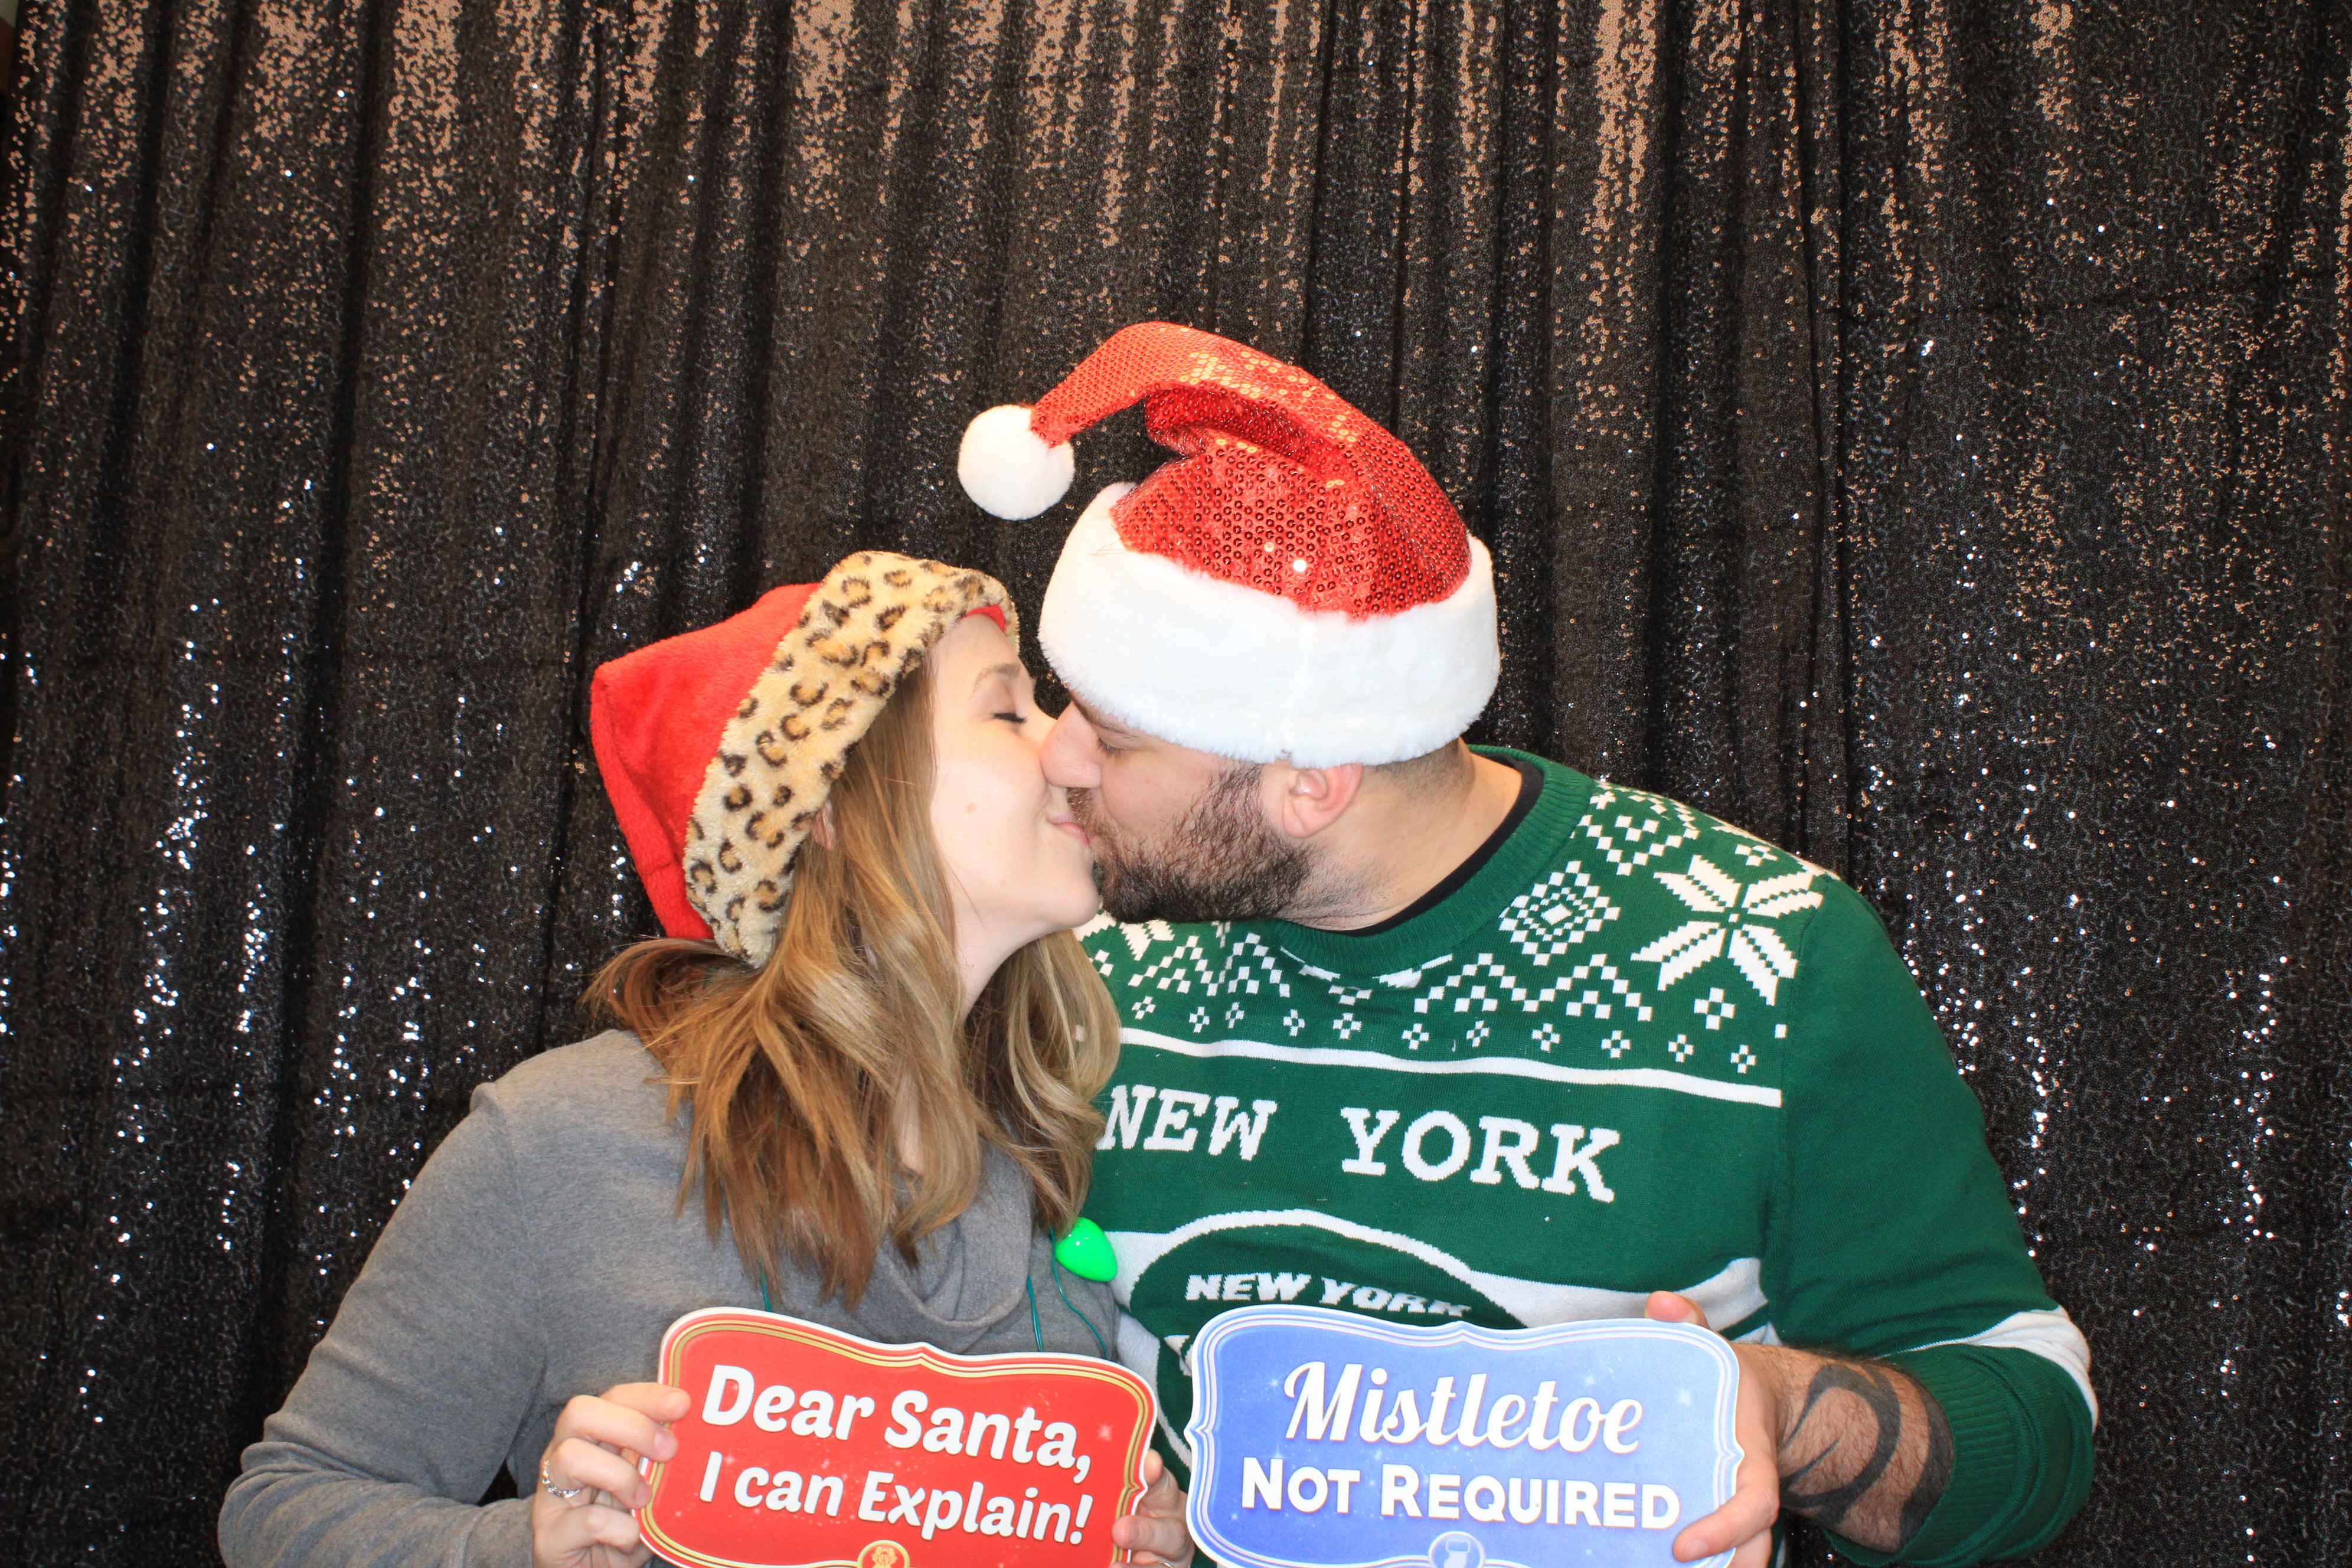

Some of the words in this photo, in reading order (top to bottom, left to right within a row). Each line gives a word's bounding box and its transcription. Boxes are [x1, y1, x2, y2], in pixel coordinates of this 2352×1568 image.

[1096, 1084, 1277, 1161] NEW
[1340, 1107, 1621, 1203] YORK
[1185, 1272, 1311, 1302] NEW
[1319, 1277, 1472, 1317] YORK
[702, 1364, 876, 1440] Dear
[884, 1390, 1092, 1484] Santa,
[1283, 1361, 1643, 1453] Mistletoe
[700, 1451, 723, 1502] I
[734, 1466, 844, 1517] can
[858, 1470, 1094, 1545] Explain!
[1241, 1456, 1361, 1514] NOT
[1380, 1464, 1681, 1530] REQUIRED
